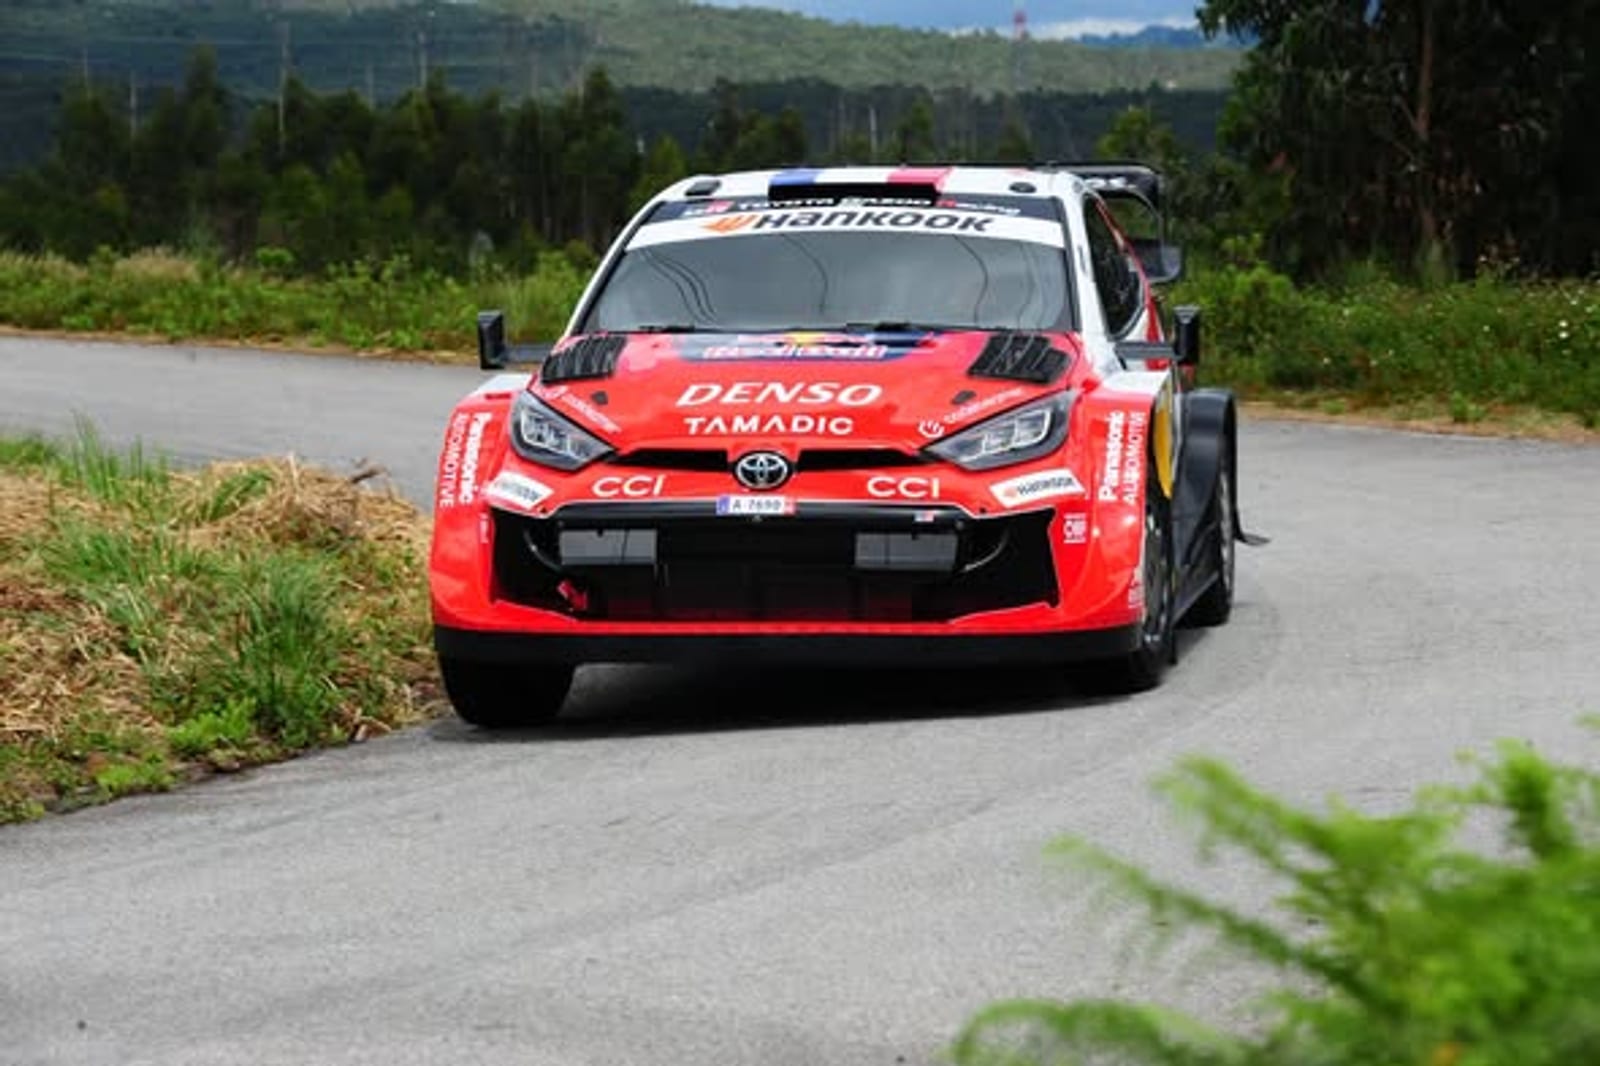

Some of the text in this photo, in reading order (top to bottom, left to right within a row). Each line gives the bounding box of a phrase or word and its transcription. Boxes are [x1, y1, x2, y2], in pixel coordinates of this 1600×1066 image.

[676, 382, 883, 406] DENSO
[683, 415, 854, 434] TAMADIC
[1098, 410, 1125, 502] Panasonic
[592, 474, 666, 497] CCI
[866, 476, 940, 498] CCI
